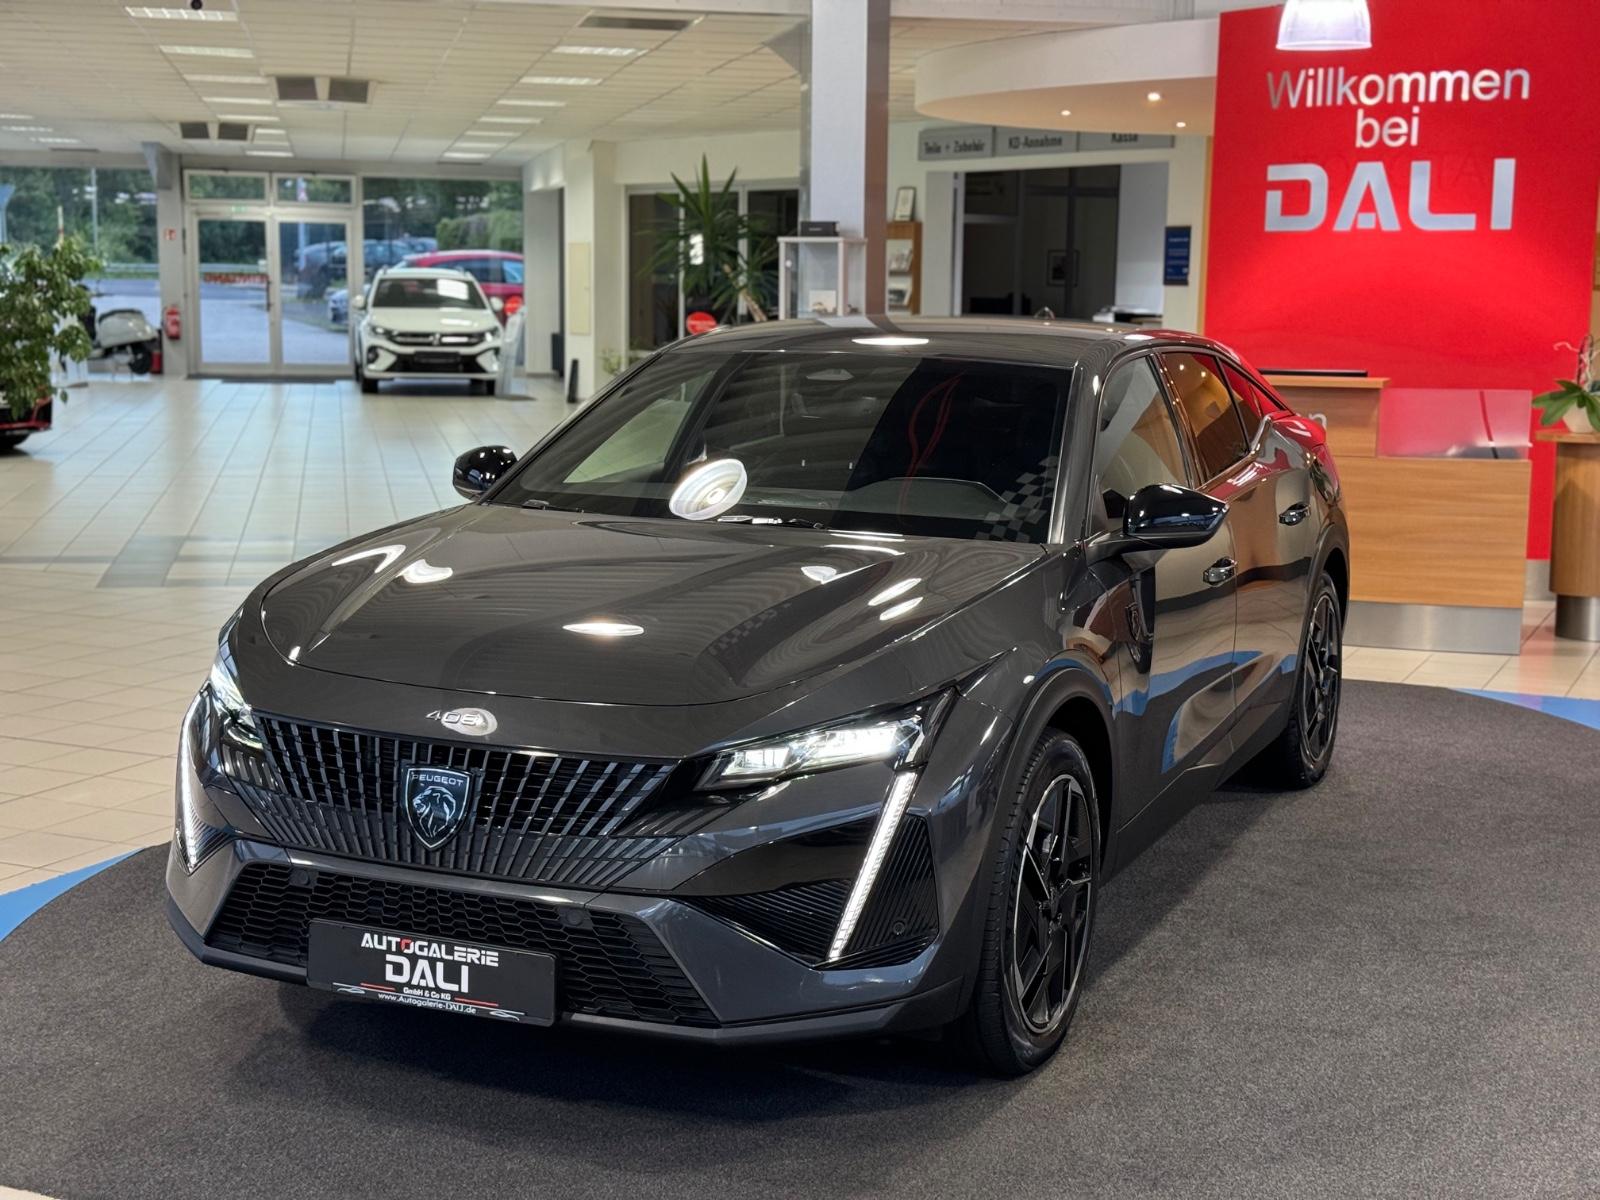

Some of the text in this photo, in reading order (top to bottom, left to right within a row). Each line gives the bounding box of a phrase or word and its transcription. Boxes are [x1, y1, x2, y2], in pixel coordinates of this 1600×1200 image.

[1266, 67, 1530, 110] Willkommen
[1355, 106, 1420, 148] bei
[1264, 157, 1517, 233] DALI
[425, 710, 482, 726] 408
[412, 773, 464, 786] PEUGEOT
[385, 953, 469, 994] DALI
[403, 986, 452, 1001] GmbH & Co KG
